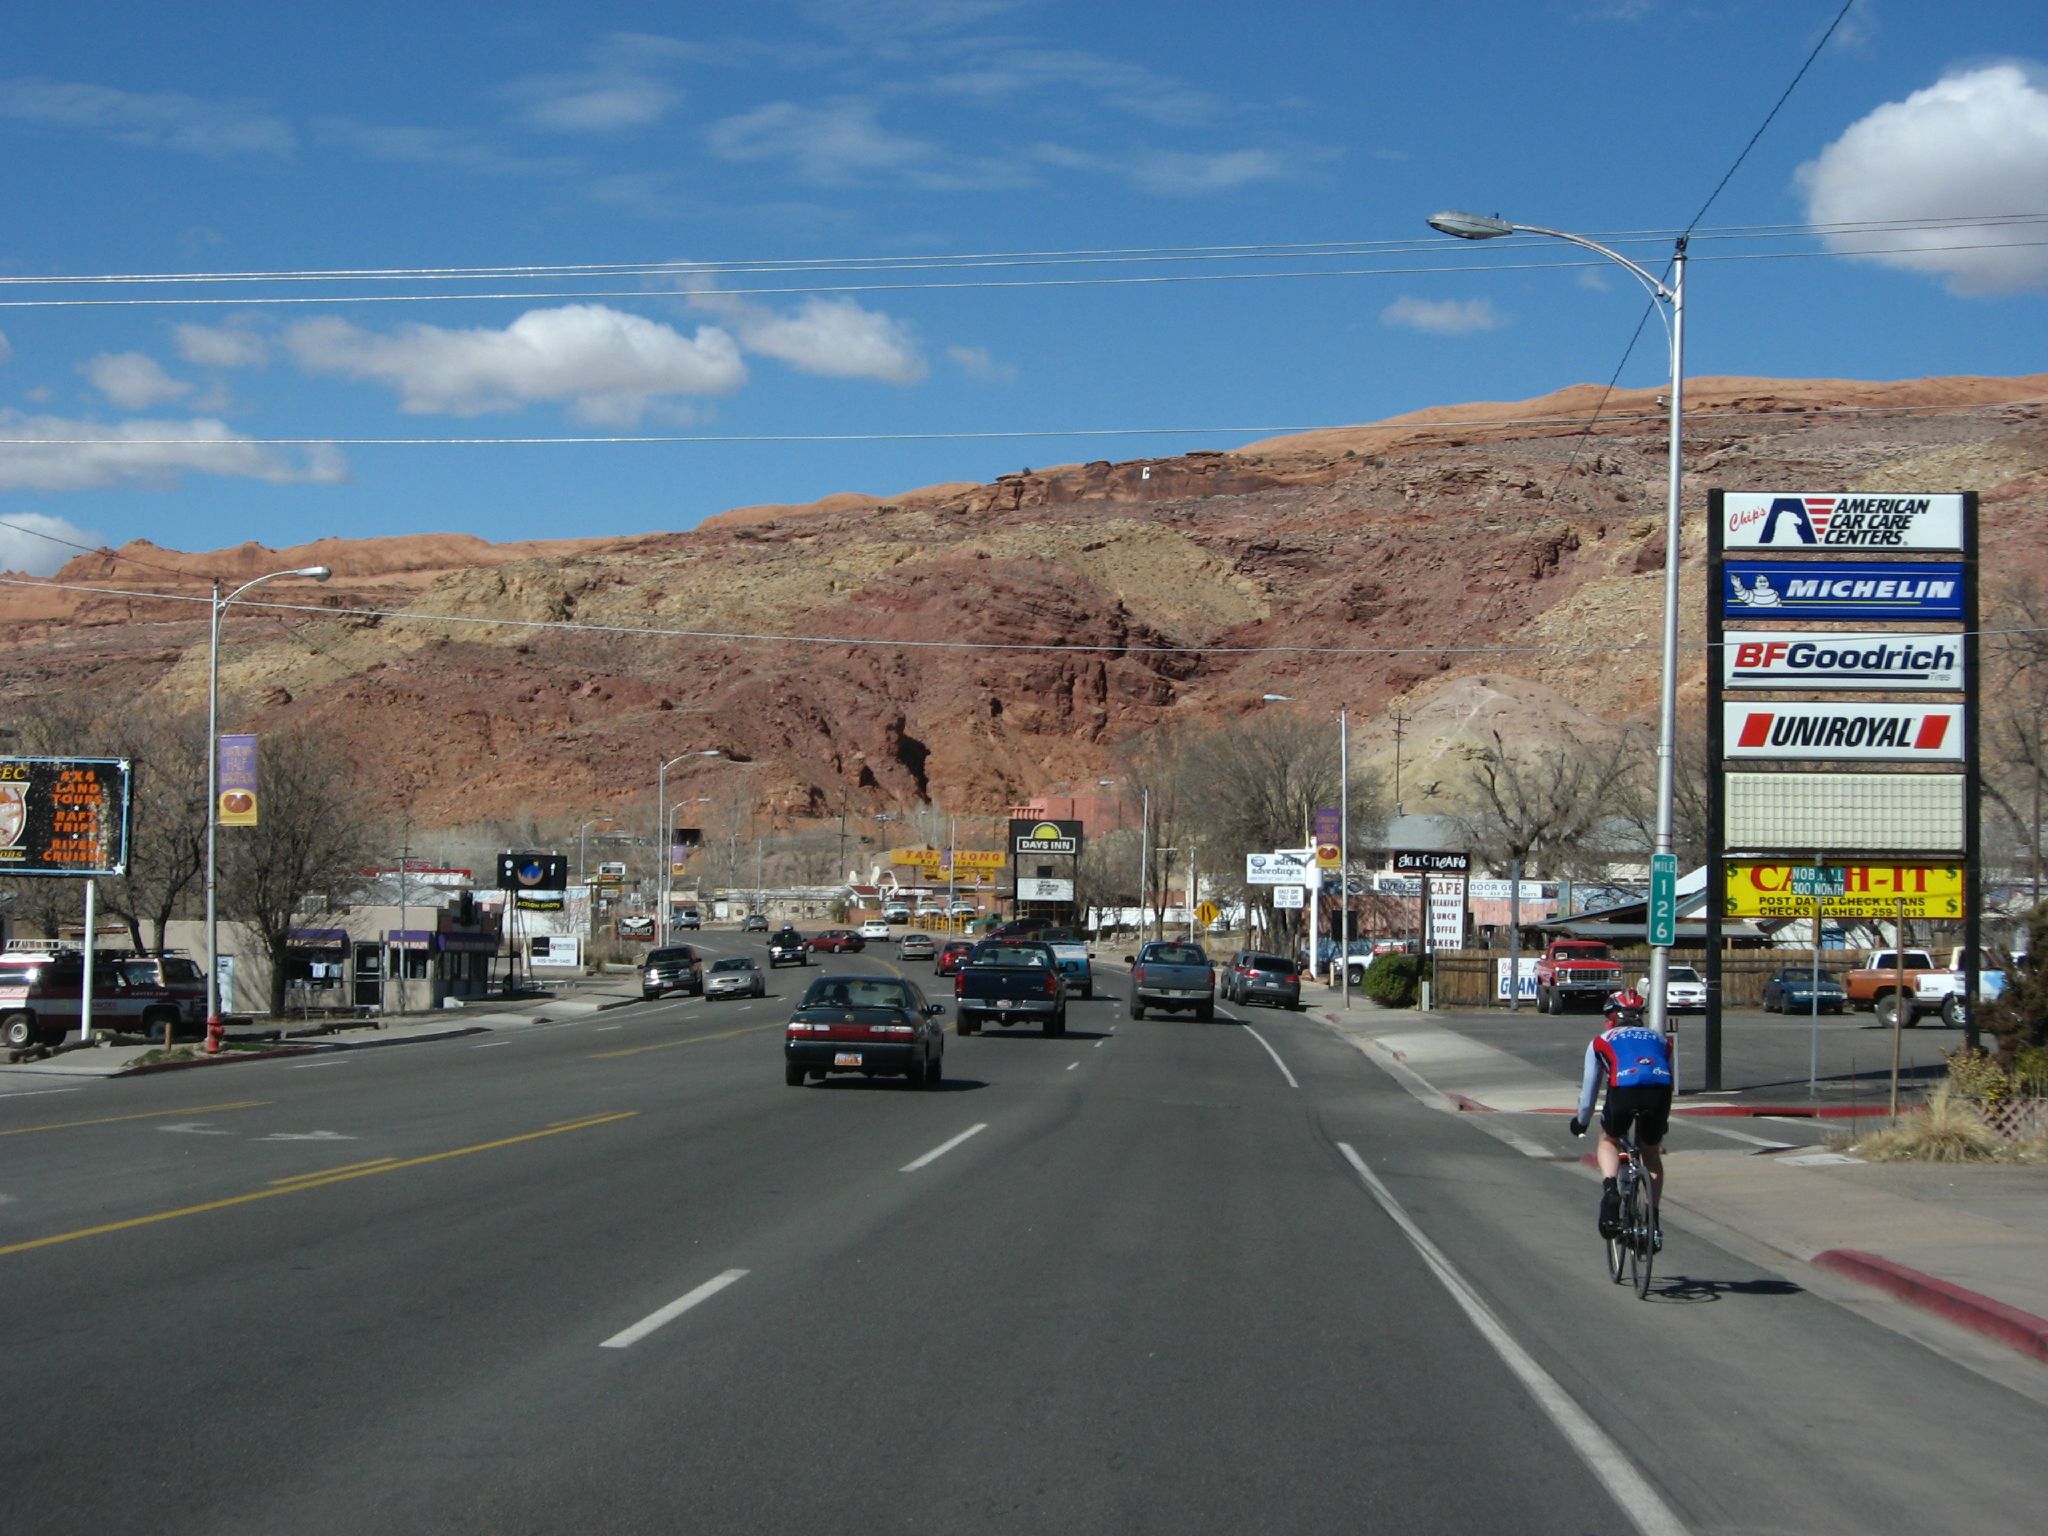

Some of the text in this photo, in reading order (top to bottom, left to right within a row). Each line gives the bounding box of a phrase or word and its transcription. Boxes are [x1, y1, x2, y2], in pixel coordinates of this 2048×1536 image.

[1834, 498, 1931, 515] AMERICAN
[1729, 505, 1767, 532] Chip's
[1830, 514, 1914, 530] CAR CARE
[1824, 529, 1905, 546] CENTERS
[1786, 579, 1956, 599] MICHELIN
[1734, 642, 1955, 671] BFGoodrich
[1770, 716, 1913, 748] UNIROYAL
[55, 783, 100, 793] LAND
[52, 793, 103, 805] TOURS
[56, 811, 97, 821] RAFT
[53, 822, 97, 833] TRIPS
[51, 840, 97, 851] RIVER
[1021, 840, 1070, 850] DAYS INN
[42, 851, 107, 862] CRUISES
[1654, 860, 1675, 873] MILE
[1750, 864, 1937, 893] CH-IT
[1792, 867, 1815, 880] NOB
[1429, 880, 1462, 895] CAFÉ
[1792, 882, 1845, 896] 300 NORTH
[1759, 896, 1791, 906] POST
[1843, 897, 1881, 906] CHECK
[1884, 897, 1926, 907] LOANS
[1432, 913, 1457, 921] LUNCH
[1759, 906, 1926, 917] CHECKS ASHED 259-013
[1431, 926, 1457, 934] COFFEE
[1427, 939, 1460, 948] BAKERY
